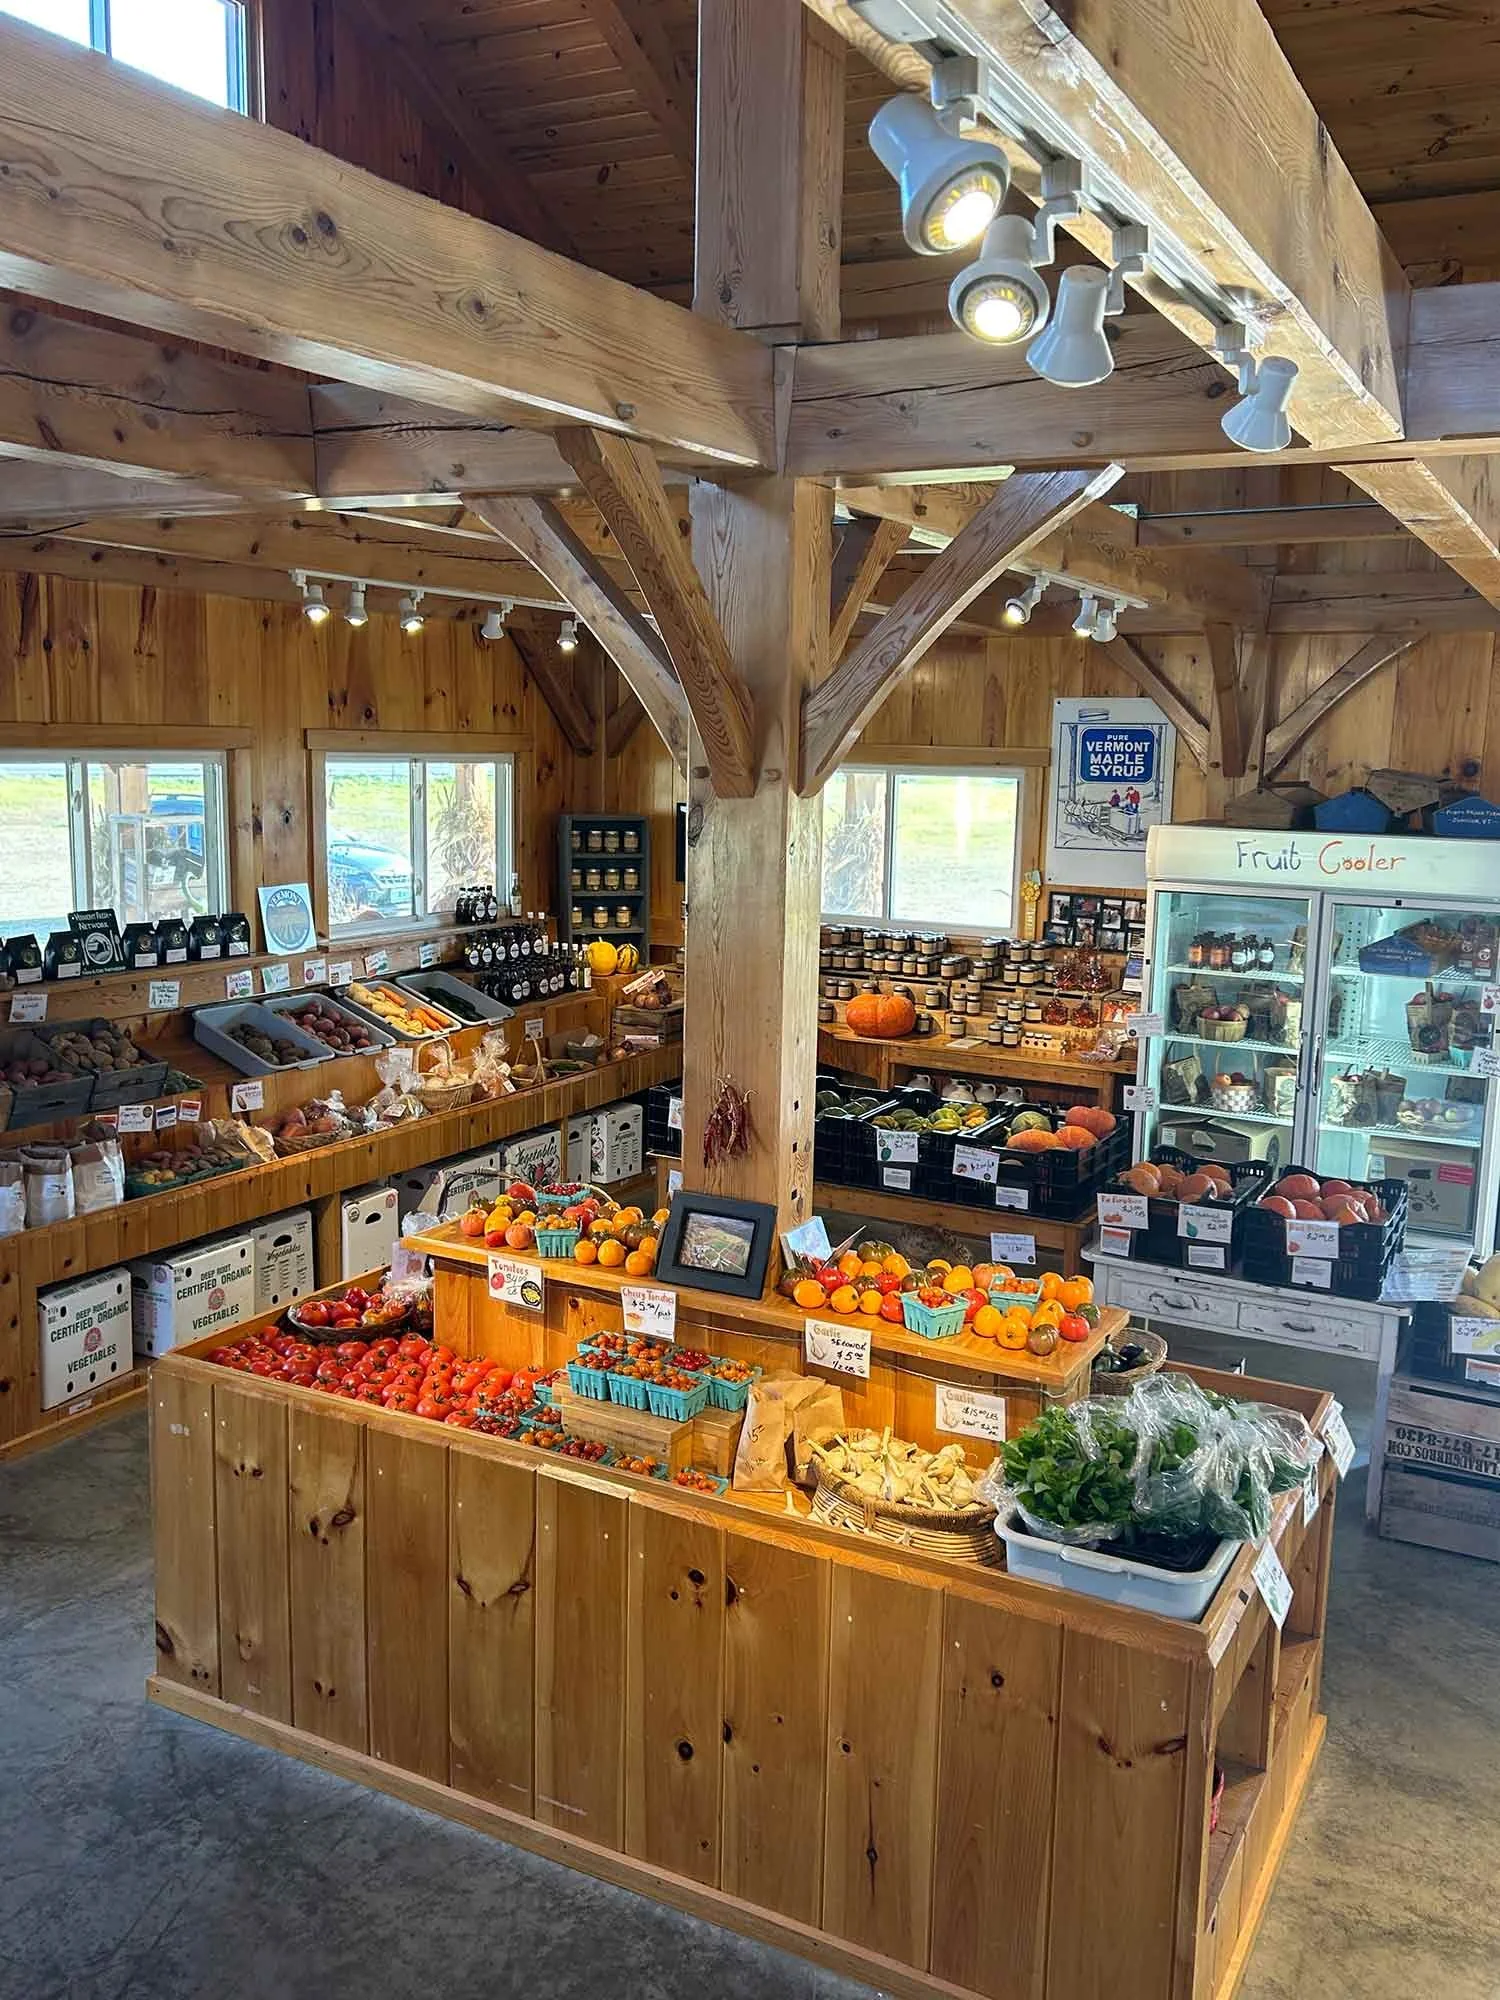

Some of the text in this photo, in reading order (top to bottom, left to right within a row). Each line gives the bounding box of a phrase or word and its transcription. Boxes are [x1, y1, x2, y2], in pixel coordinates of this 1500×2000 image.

[1086, 741, 1151, 753] VERMONT
[1089, 753, 1145, 765] MAPLE
[1089, 765, 1145, 777] SYRUP
[1235, 839, 1407, 875] Fruit Cooler
[515, 1144, 558, 1170] Vegetables
[201, 1269, 216, 1281] DEEP
[491, 1259, 529, 1276] Tomatoes
[176, 1277, 217, 1300] CERTIFIED
[221, 1265, 253, 1285] ORGANIC
[50, 1300, 130, 1343] CERTIFIED ORGANIC
[76, 1307, 92, 1321] DEEP
[192, 1303, 240, 1330] VEGETABLES
[814, 1324, 841, 1338] Garlic
[68, 1344, 117, 1374] VEGETABLES
[946, 1389, 976, 1405] Garlic
